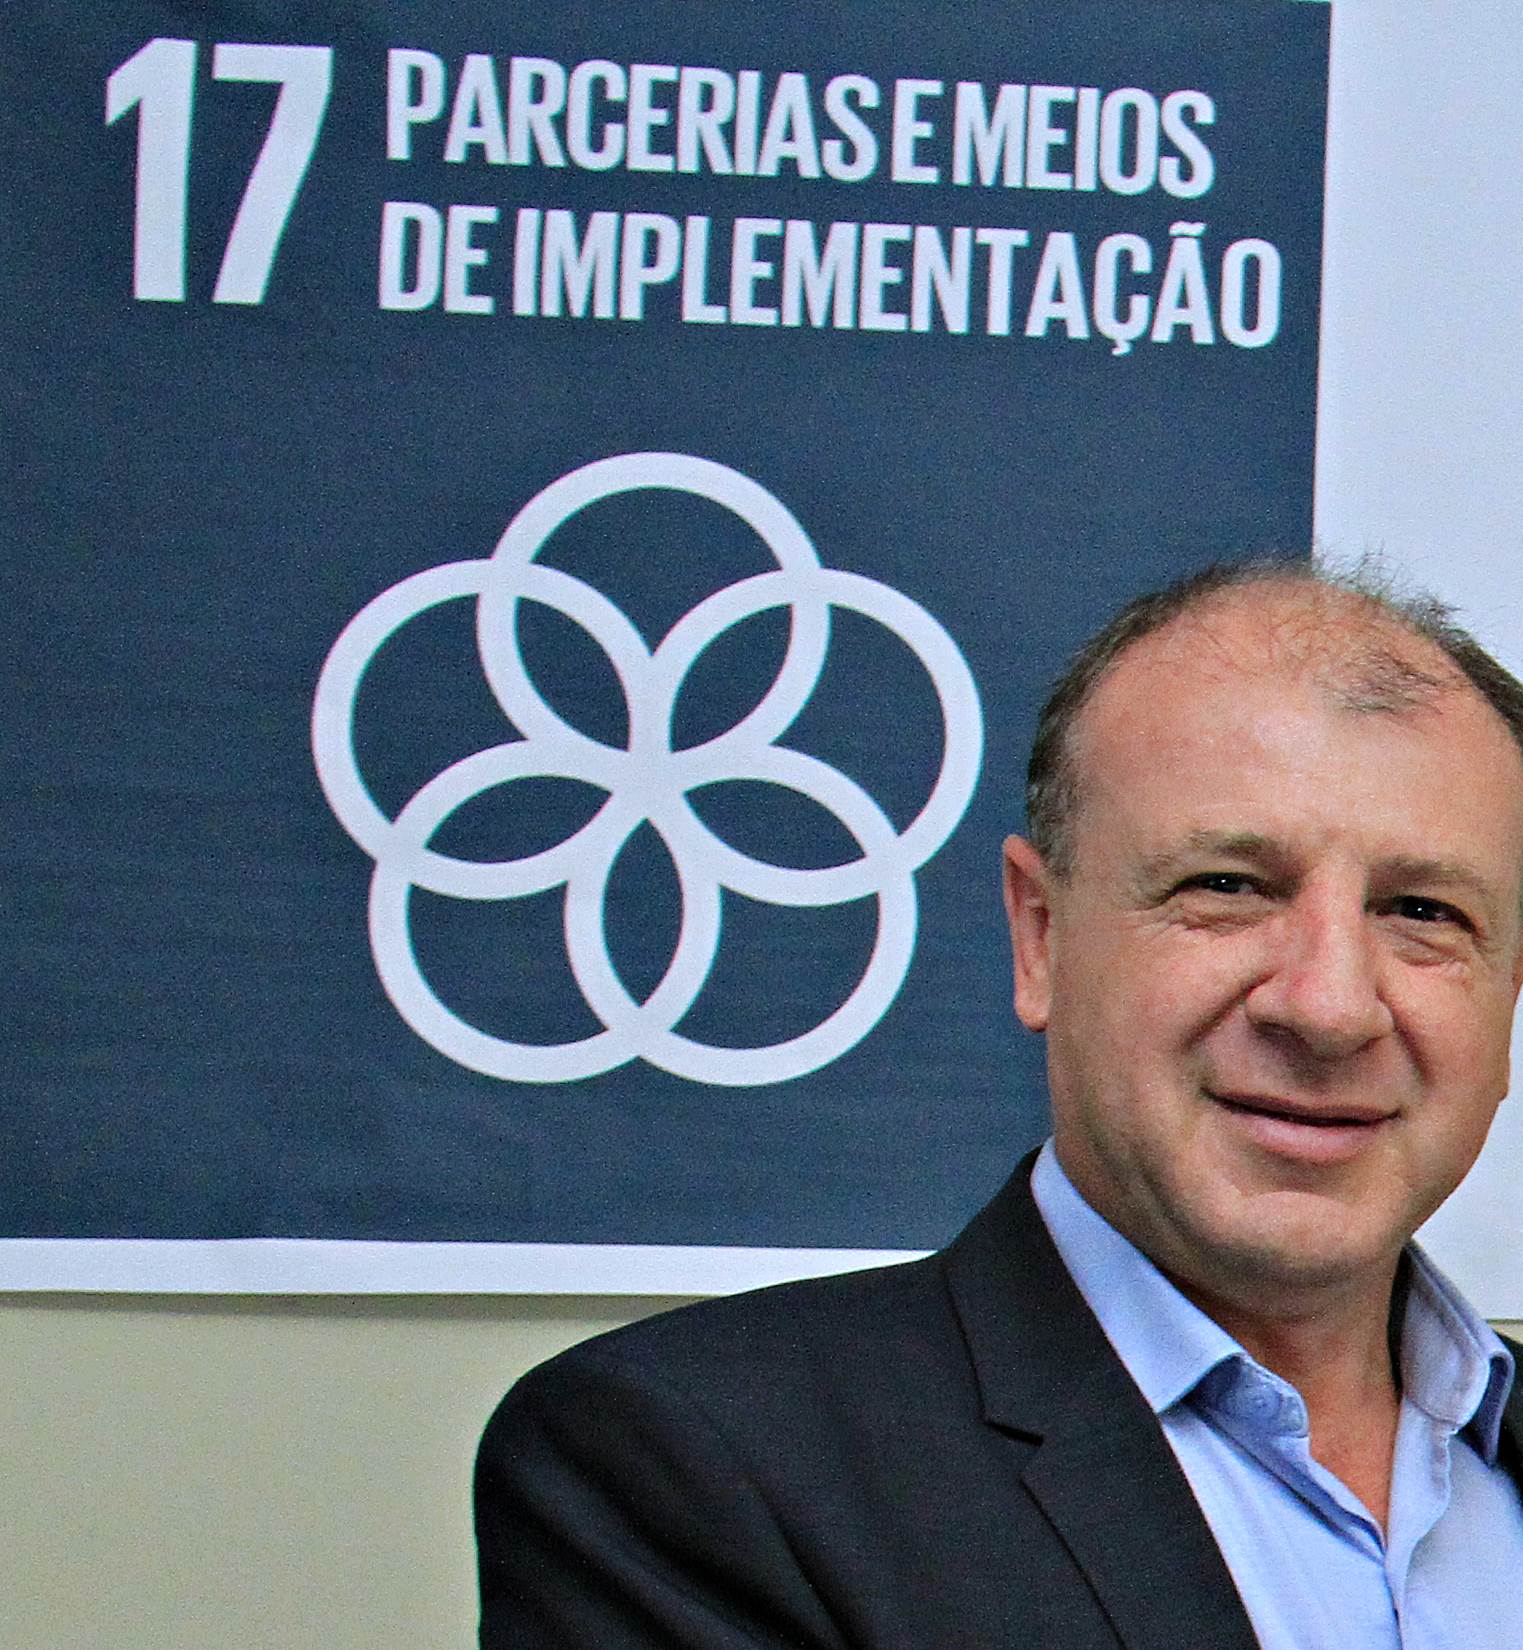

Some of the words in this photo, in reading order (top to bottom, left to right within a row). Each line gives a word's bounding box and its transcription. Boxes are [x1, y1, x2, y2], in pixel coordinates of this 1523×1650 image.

[106, 38, 331, 303] 17
[387, 49, 877, 181] PARCERIAS
[892, 78, 942, 183] E
[953, 82, 1214, 198] MEIOS
[379, 201, 496, 312] DE
[513, 207, 1281, 356] IMPLEMENTAÇÃO
